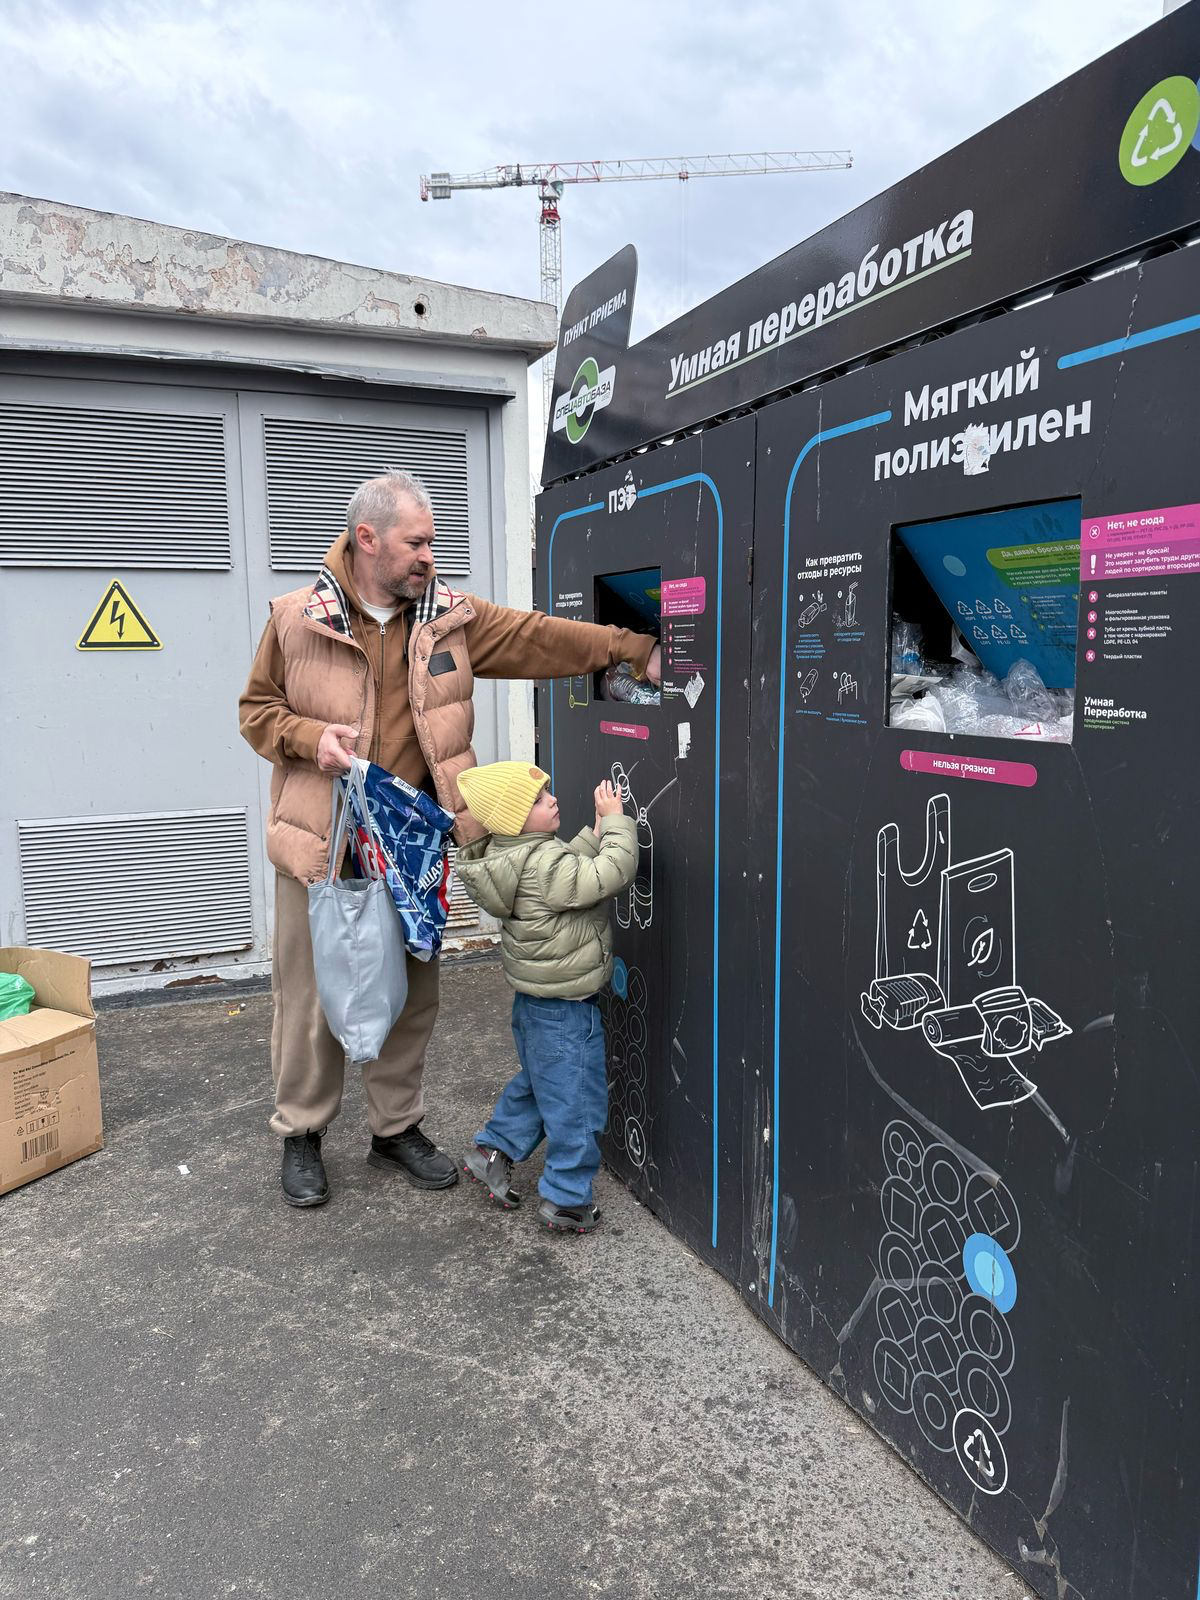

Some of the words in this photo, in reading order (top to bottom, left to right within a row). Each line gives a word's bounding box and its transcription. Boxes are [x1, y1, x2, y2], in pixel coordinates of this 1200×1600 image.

[667, 331, 741, 391] Умная
[746, 209, 975, 354] переработка
[563, 315, 590, 347] ПУНКТ
[589, 288, 627, 329] ПРИЕМА
[903, 346, 1040, 427] Мягкий
[556, 381, 611, 419] СПЕЦАВТОБАЗА
[874, 399, 1092, 481] полиэилен
[608, 485, 637, 514] ПЭ
[1107, 521, 1125, 530] Нет,
[1127, 519, 1138, 528] не
[1140, 516, 1165, 526] сюда
[805, 557, 819, 568] Как
[819, 552, 863, 567] превратить
[1113, 551, 1134, 560] уверен
[1146, 547, 1170, 556] бросай!
[1134, 557, 1160, 565] загубить
[1160, 555, 1179, 563] труды
[797, 569, 823, 580] отходы
[823, 568, 829, 577] в
[829, 564, 862, 578] ресурсы
[1104, 567, 1124, 575] людей
[1131, 564, 1166, 573] сортировке
[1166, 561, 1200, 570] вторсырья
[1084, 696, 1114, 707] Умная
[1083, 706, 1147, 719] Переработка
[932, 760, 960, 770] НЕЛЬЗЯ
[960, 763, 996, 775] ГРЯЗНОЕ!
